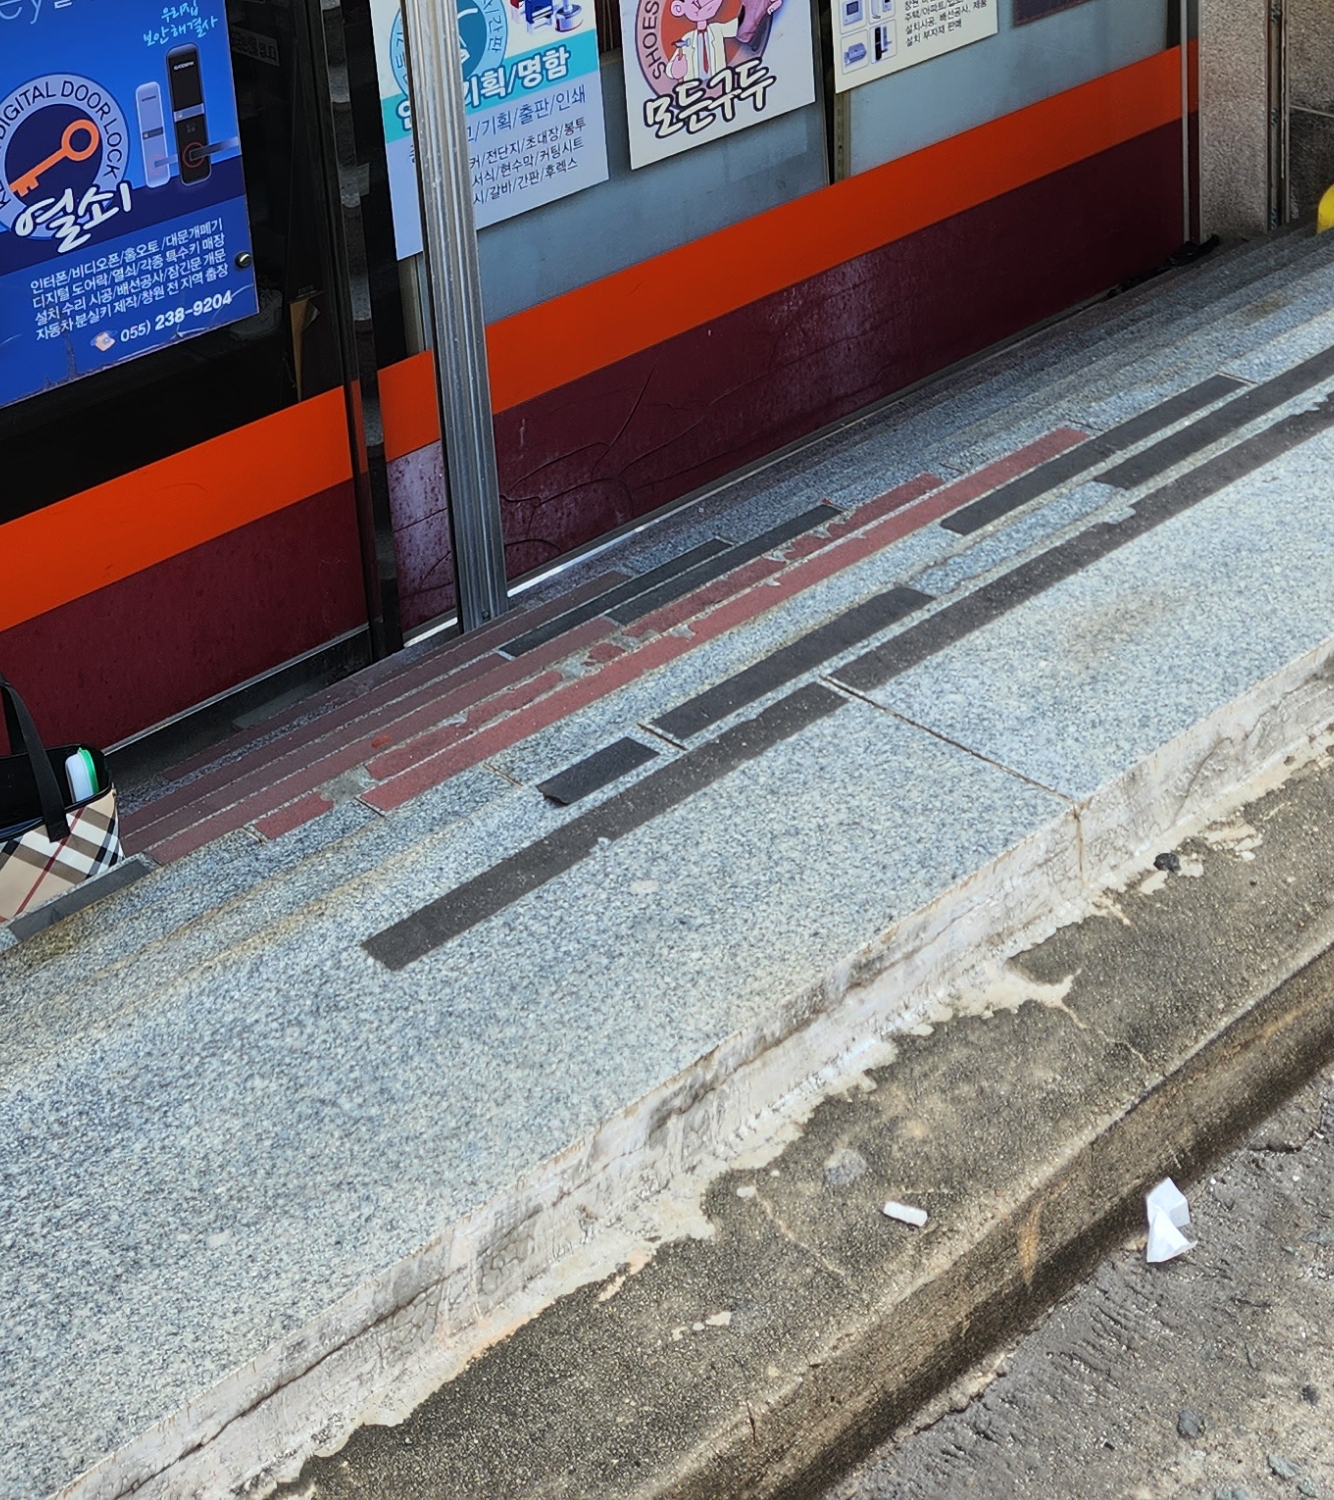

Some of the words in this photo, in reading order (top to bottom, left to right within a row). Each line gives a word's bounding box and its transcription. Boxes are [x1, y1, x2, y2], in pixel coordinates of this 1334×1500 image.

[642, 0, 667, 80] SHOES
[60, 80, 112, 121] DOOR
[102, 117, 124, 181] LOCK
[14, 182, 132, 254] 열쇠
[33, 286, 70, 309] 디지털
[120, 319, 152, 343] 055)
[154, 290, 233, 331] 238-9204
[36, 318, 75, 342] 자동차
